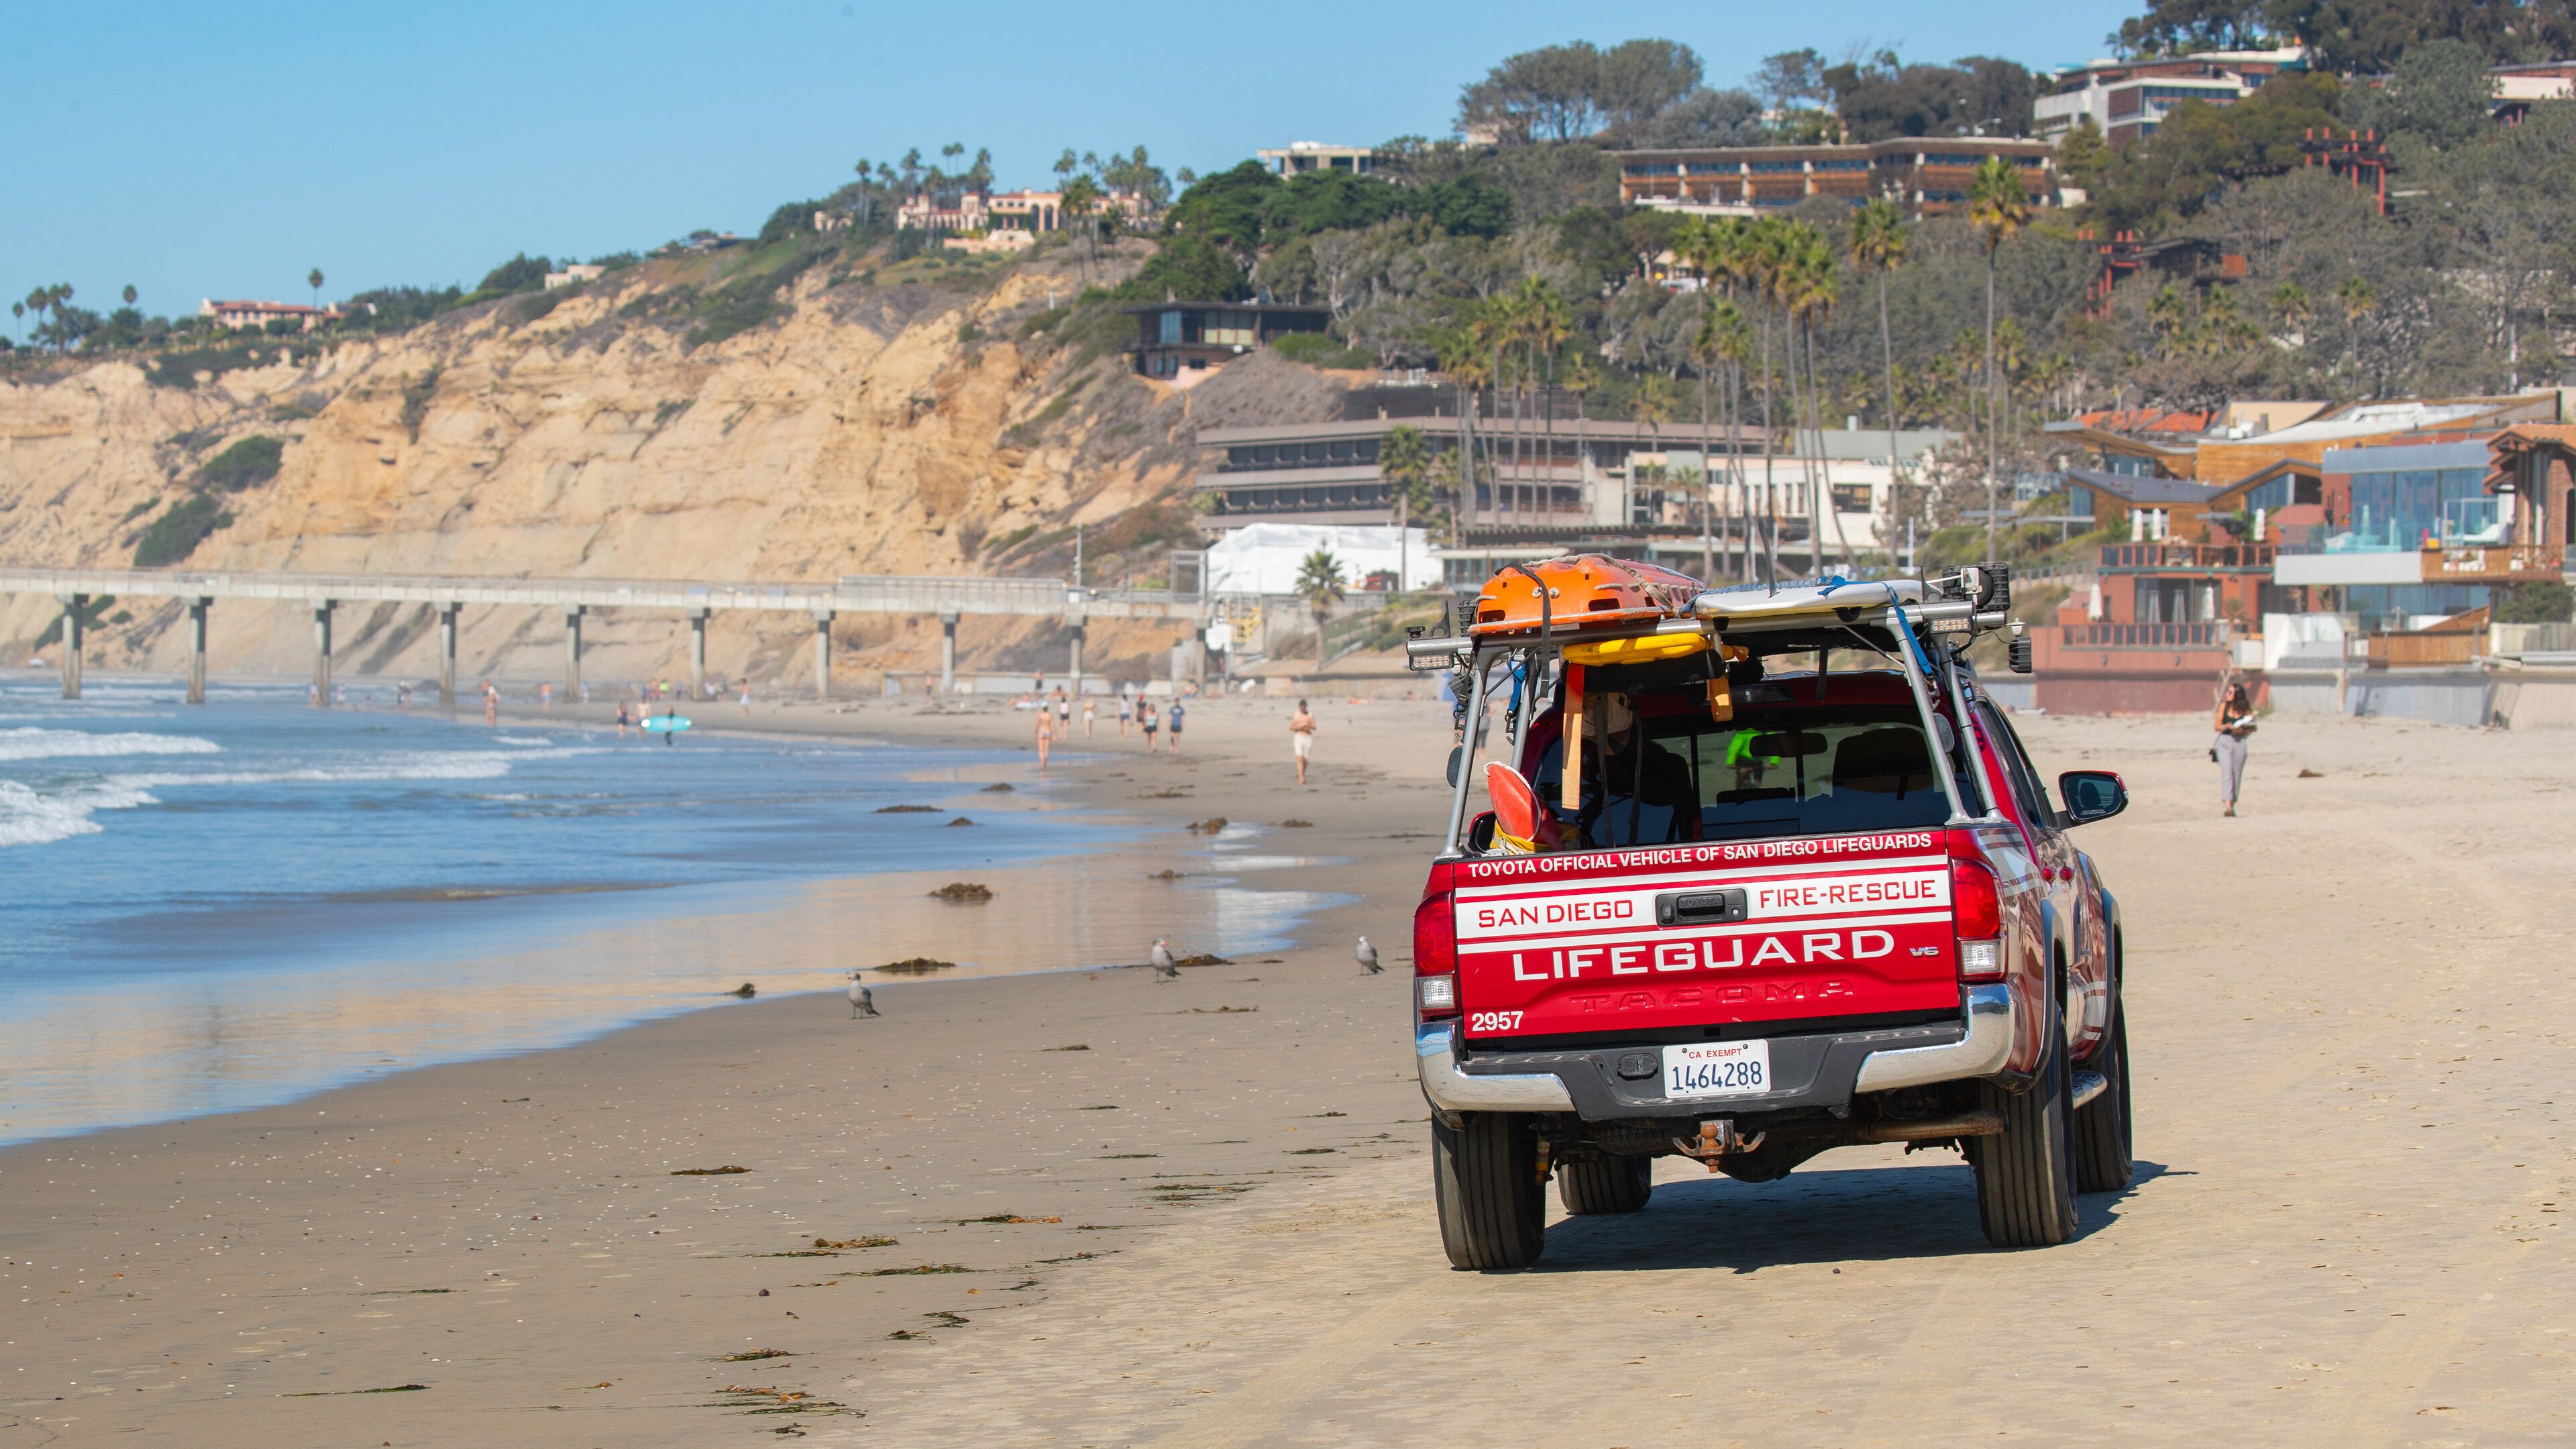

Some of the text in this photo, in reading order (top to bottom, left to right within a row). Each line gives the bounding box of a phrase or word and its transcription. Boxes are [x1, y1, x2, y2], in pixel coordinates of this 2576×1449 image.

[1468, 833, 1932, 877] TOYOTA OFFICIAL VEHICLE OF SAN DIEGO LIFEGUARDS
[1479, 879, 1937, 928] SAN DIEGO FIRE-RESCUE
[1682, 897, 1721, 908] TOYOTA
[1513, 930, 1894, 981] LIFEGUARD
[1909, 947, 1939, 957] V6
[1568, 979, 1854, 1013] TACOMA
[1472, 1011, 1523, 1032] 2957
[1688, 1048, 1742, 1059] CA EXEMPT
[1672, 1061, 1762, 1091] 1464288
